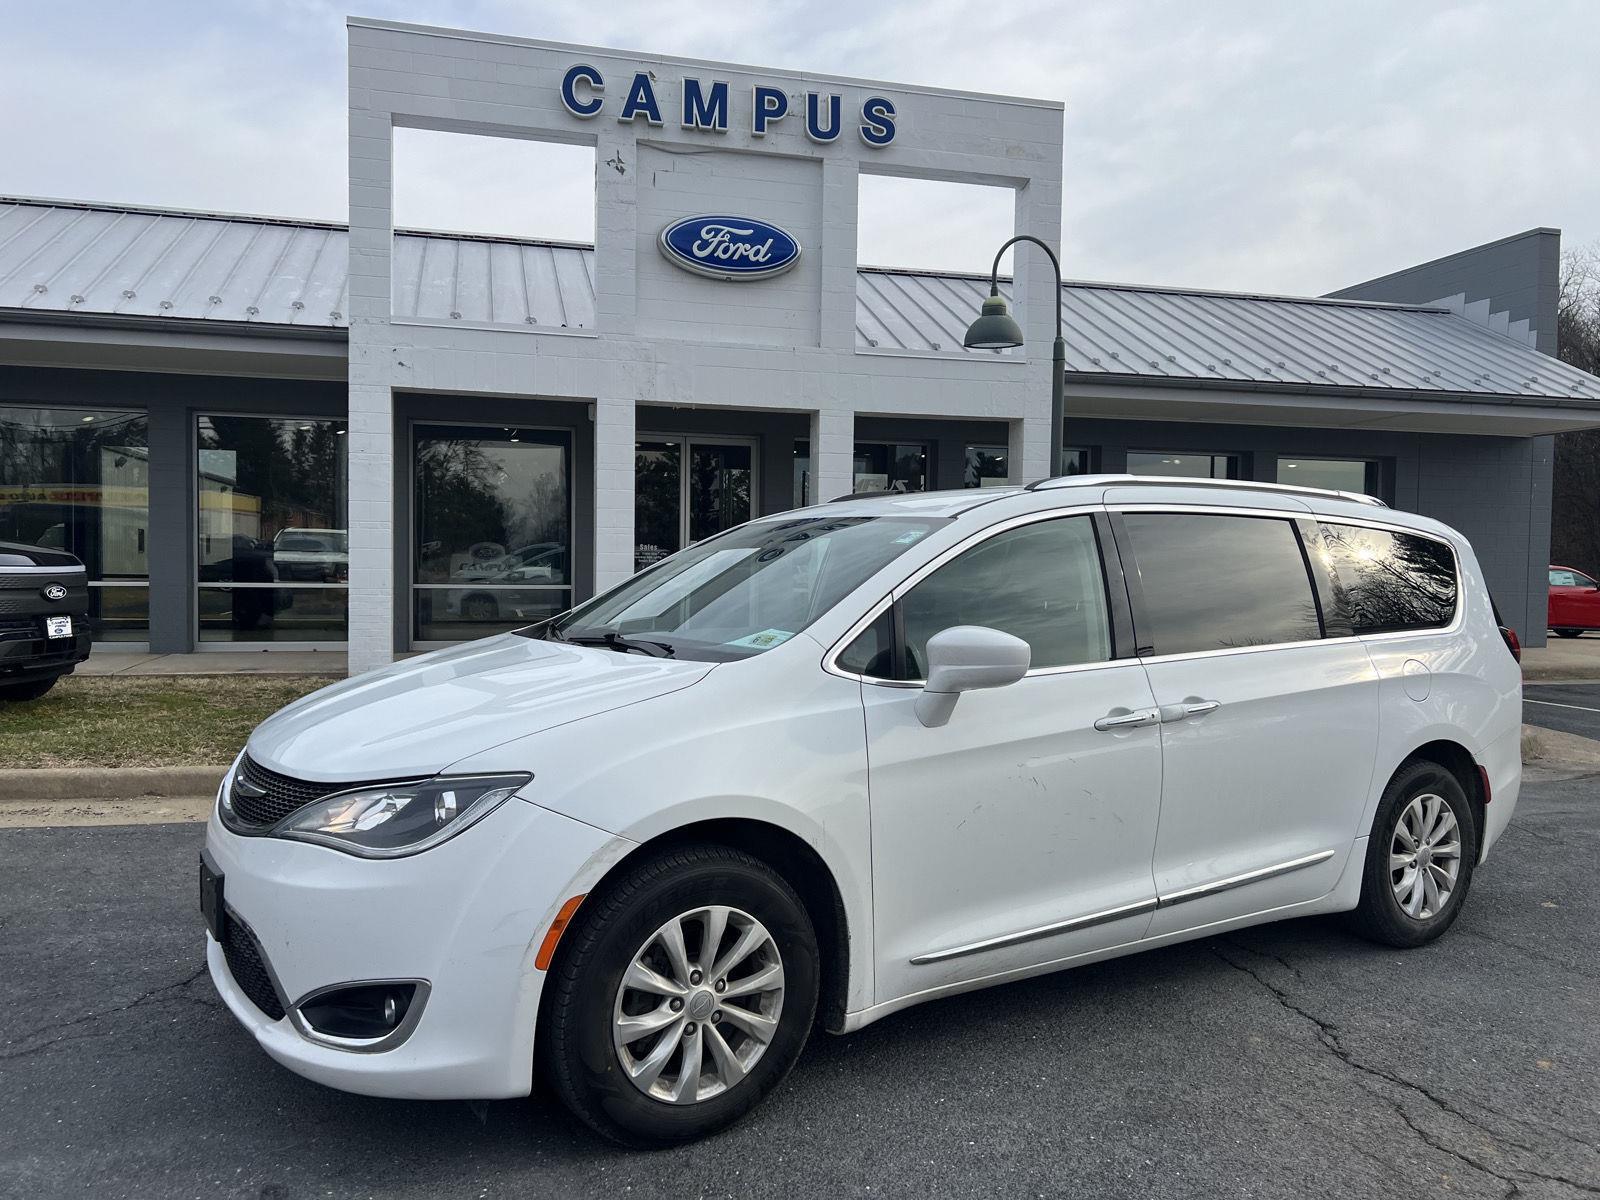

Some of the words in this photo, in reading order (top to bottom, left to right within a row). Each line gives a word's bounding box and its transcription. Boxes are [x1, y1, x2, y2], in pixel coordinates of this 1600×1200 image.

[560, 63, 898, 148] CAMPUS
[692, 223, 774, 263] Ford
[639, 543, 658, 551] Sales
